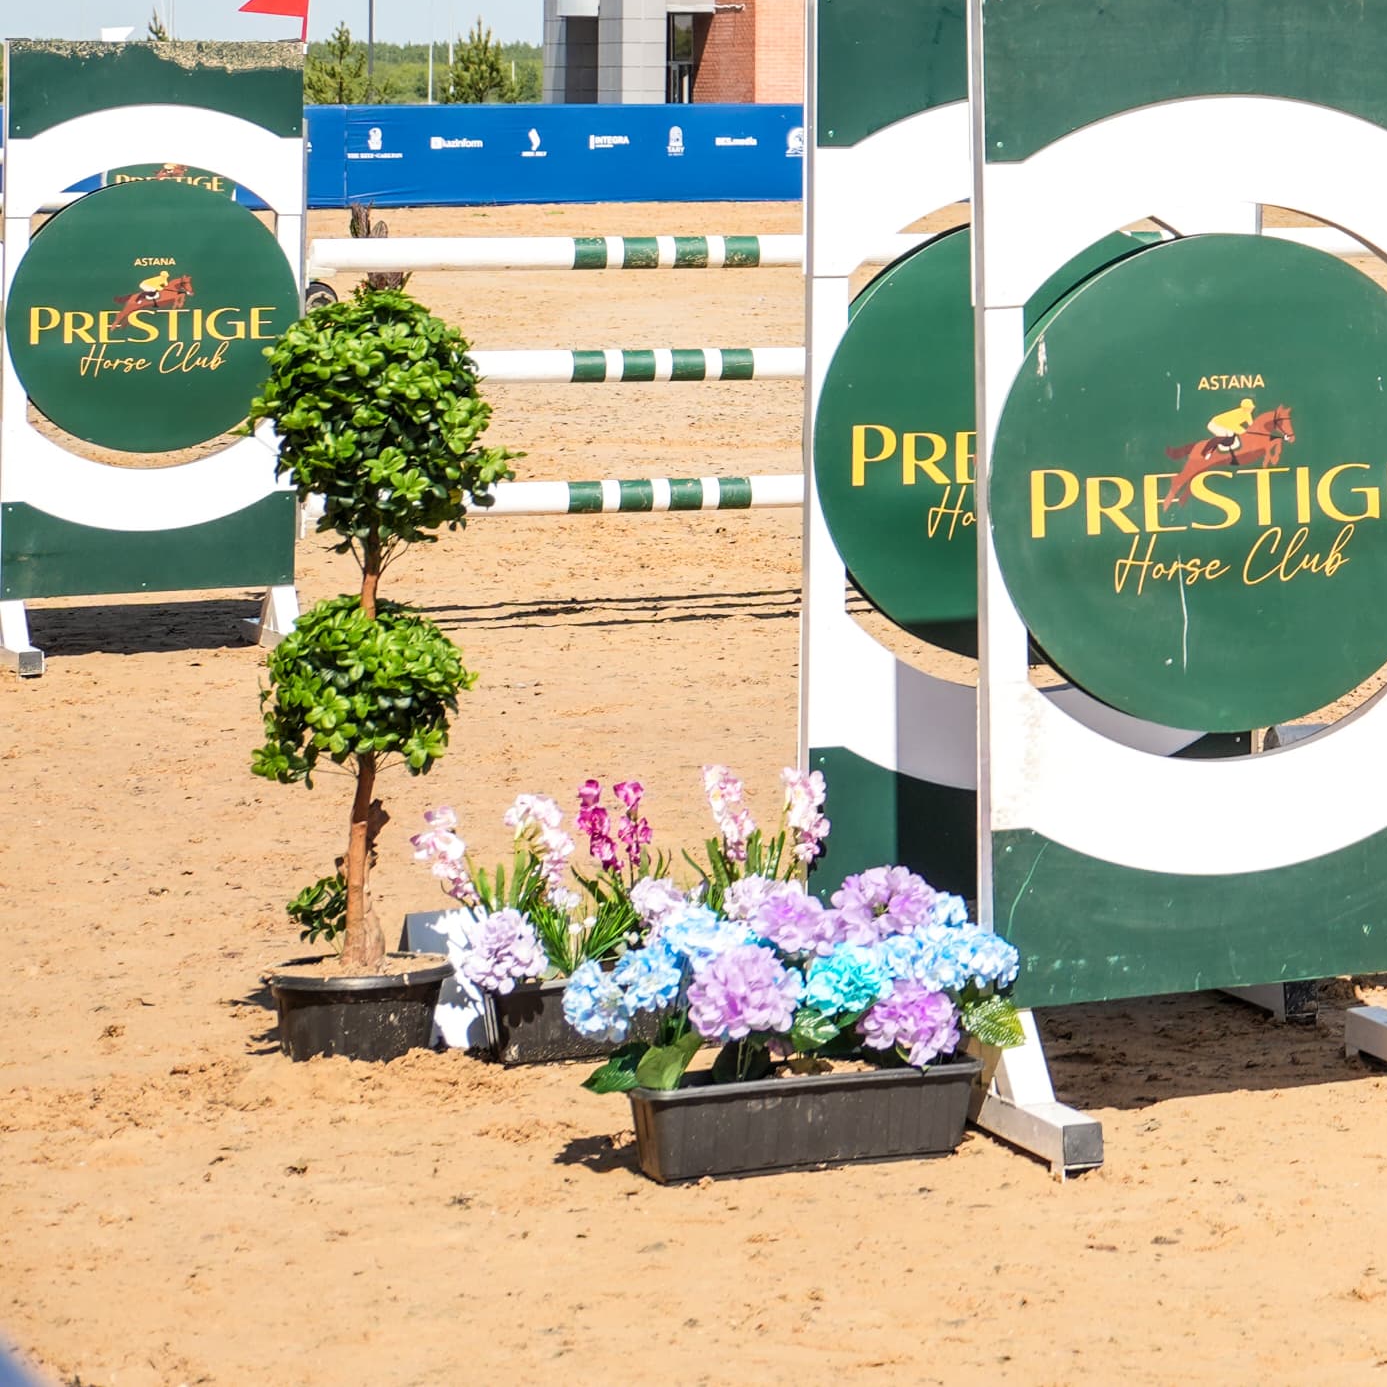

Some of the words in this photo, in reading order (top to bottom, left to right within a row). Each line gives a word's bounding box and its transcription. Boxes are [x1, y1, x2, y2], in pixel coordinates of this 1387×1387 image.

[134, 258, 176, 267] ASTANA
[30, 306, 277, 346] PRESTIGE
[80, 343, 151, 377] Horse
[159, 340, 229, 374] Club
[1198, 374, 1266, 391] ASTANA
[852, 424, 977, 487] PRE
[927, 484, 977, 542] Ho
[1114, 533, 1231, 596] Horse
[1242, 523, 1355, 586] Club
